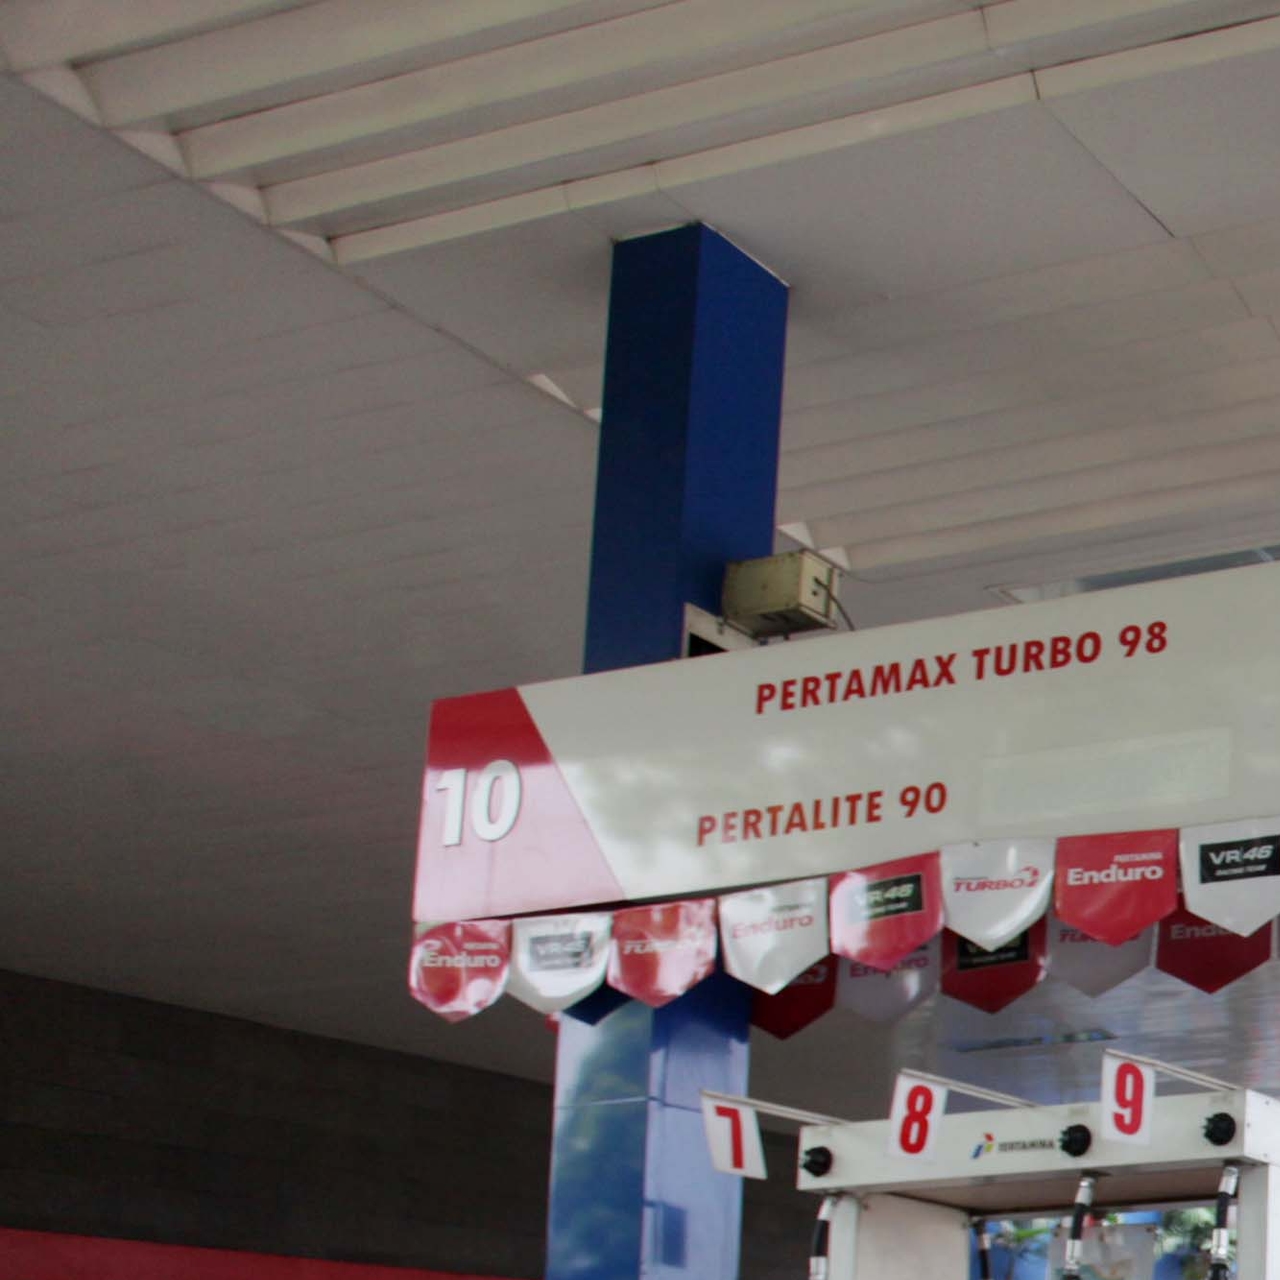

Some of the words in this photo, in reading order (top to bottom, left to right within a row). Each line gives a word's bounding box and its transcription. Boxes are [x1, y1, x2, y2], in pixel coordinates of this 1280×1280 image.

[755, 653, 956, 714] PERTAMAX
[972, 631, 1102, 681] TURBO
[1119, 621, 1168, 658] 98
[435, 759, 523, 847] 10
[697, 790, 883, 848] PERTALITE
[900, 781, 948, 818] 90
[1067, 867, 1164, 886] Enduro
[422, 952, 501, 968] Enduro
[899, 1085, 933, 1154] 8
[1113, 1061, 1144, 1135] 9
[714, 1105, 743, 1169] 7
